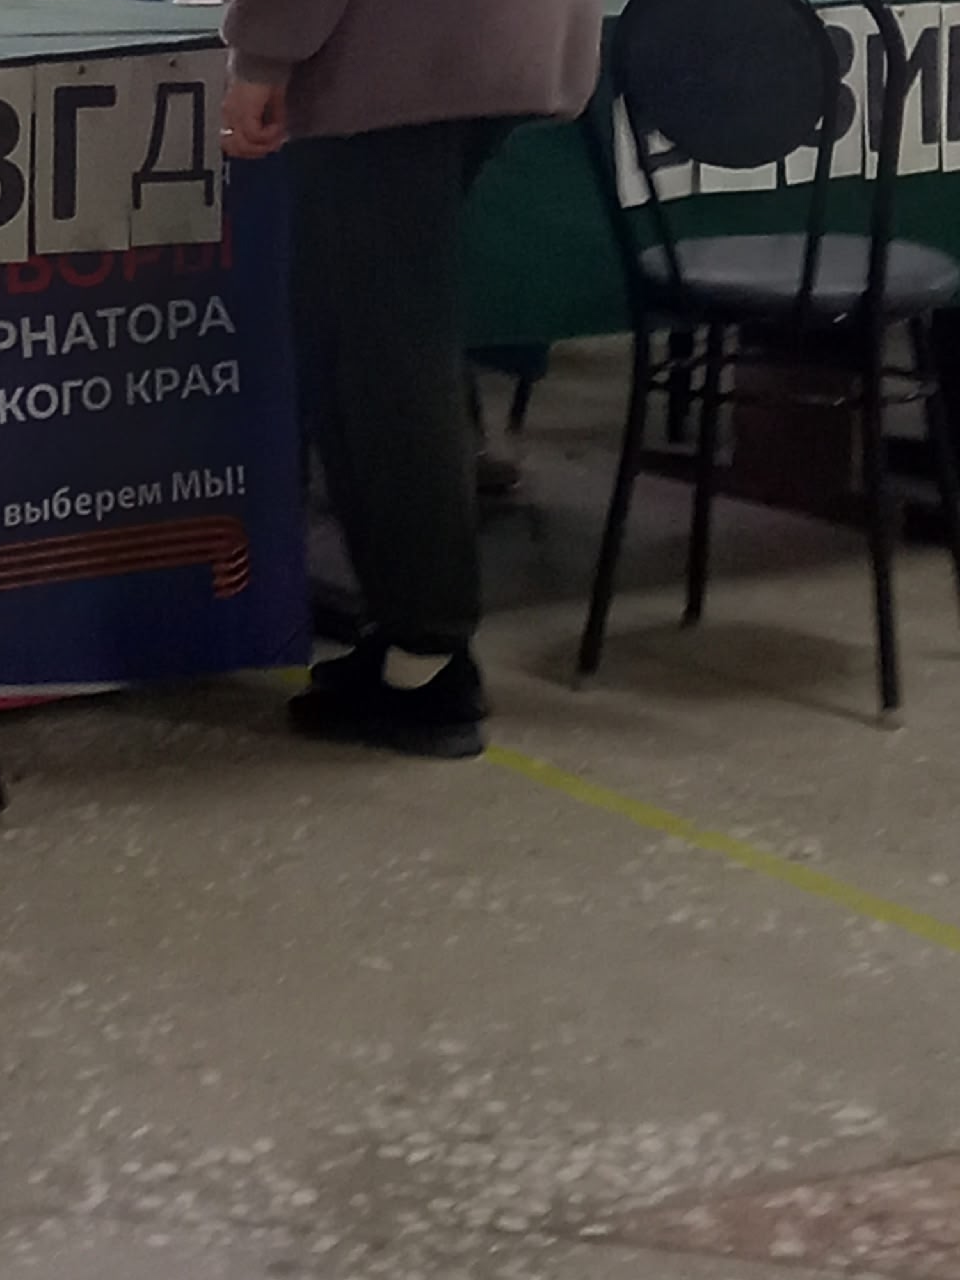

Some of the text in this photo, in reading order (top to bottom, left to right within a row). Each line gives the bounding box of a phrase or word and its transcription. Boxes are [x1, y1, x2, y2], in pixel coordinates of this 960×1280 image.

[52, 84, 117, 221] Г
[130, 81, 215, 211] Д
[125, 359, 241, 407] КРАЯ
[2, 480, 163, 529] выберем
[171, 464, 248, 504] МЫ!
